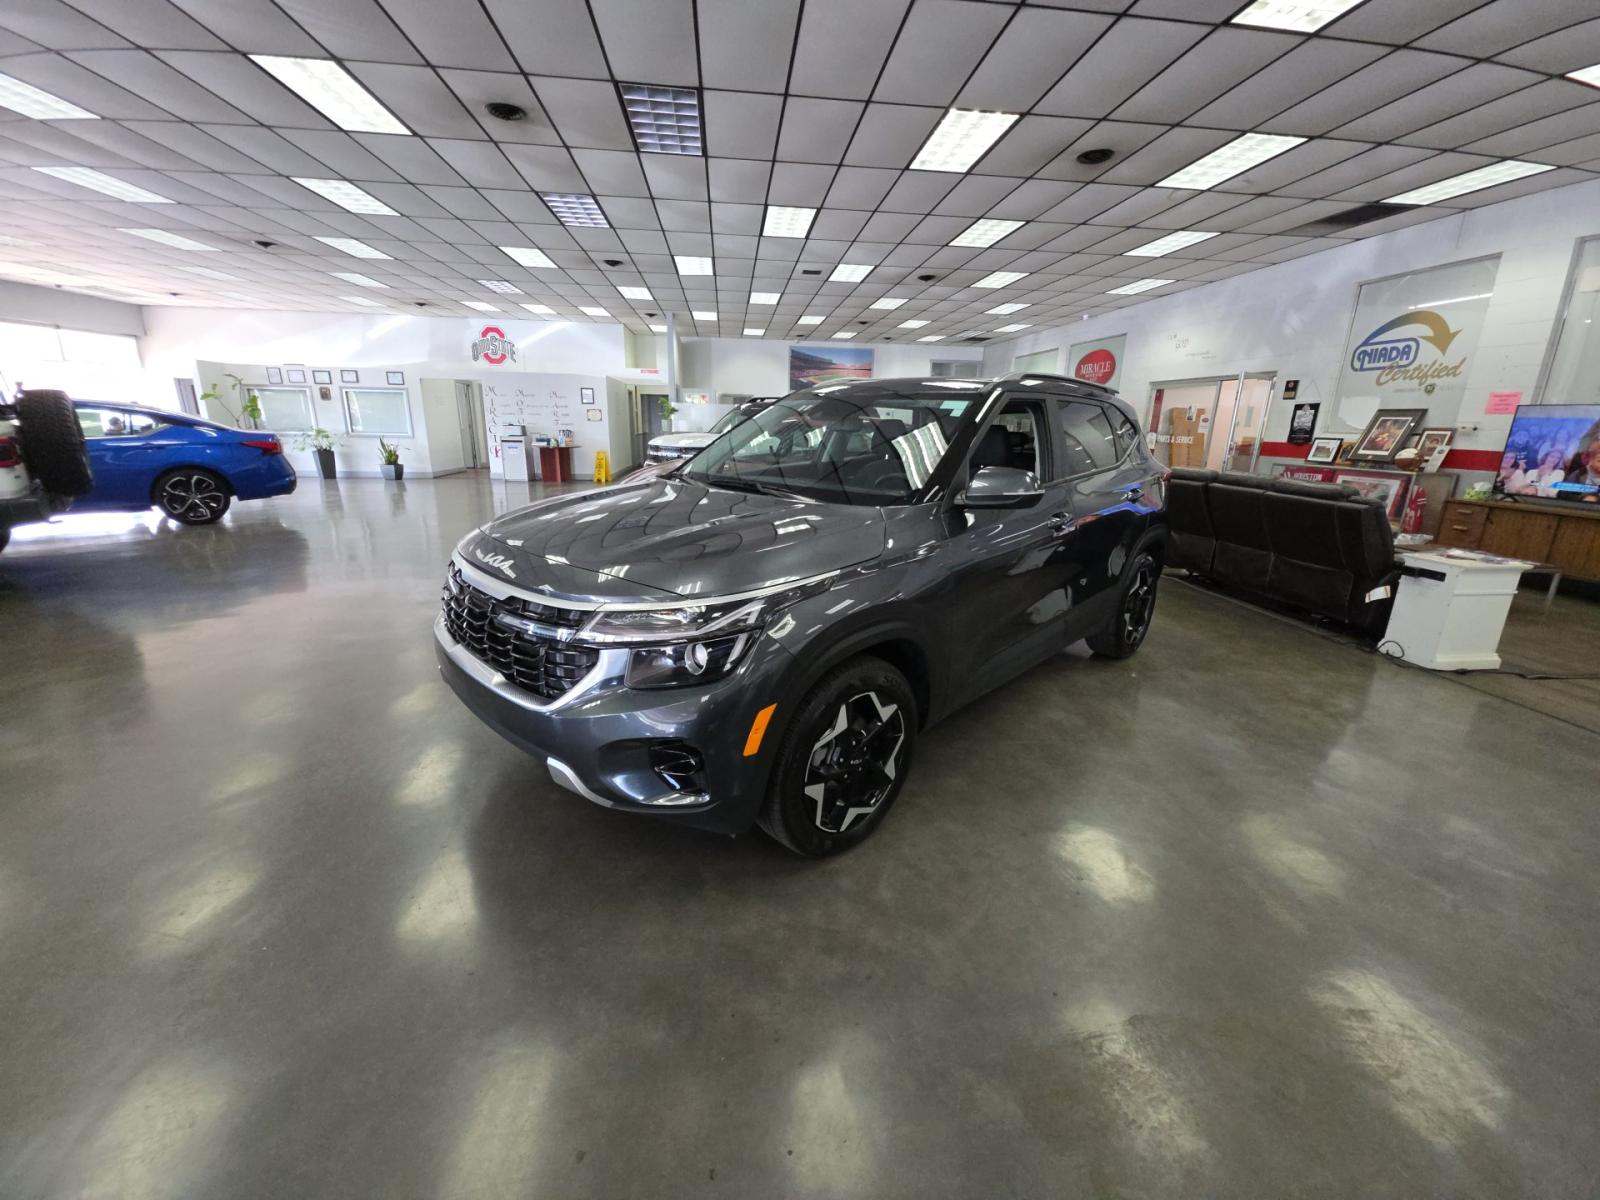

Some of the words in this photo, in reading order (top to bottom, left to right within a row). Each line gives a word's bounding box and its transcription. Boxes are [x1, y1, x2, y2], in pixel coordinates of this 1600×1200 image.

[1080, 360, 1112, 375] MIRACLE
[1356, 344, 1412, 369] NIADA
[1376, 357, 1467, 386] Certified
[475, 548, 516, 579] KIA
